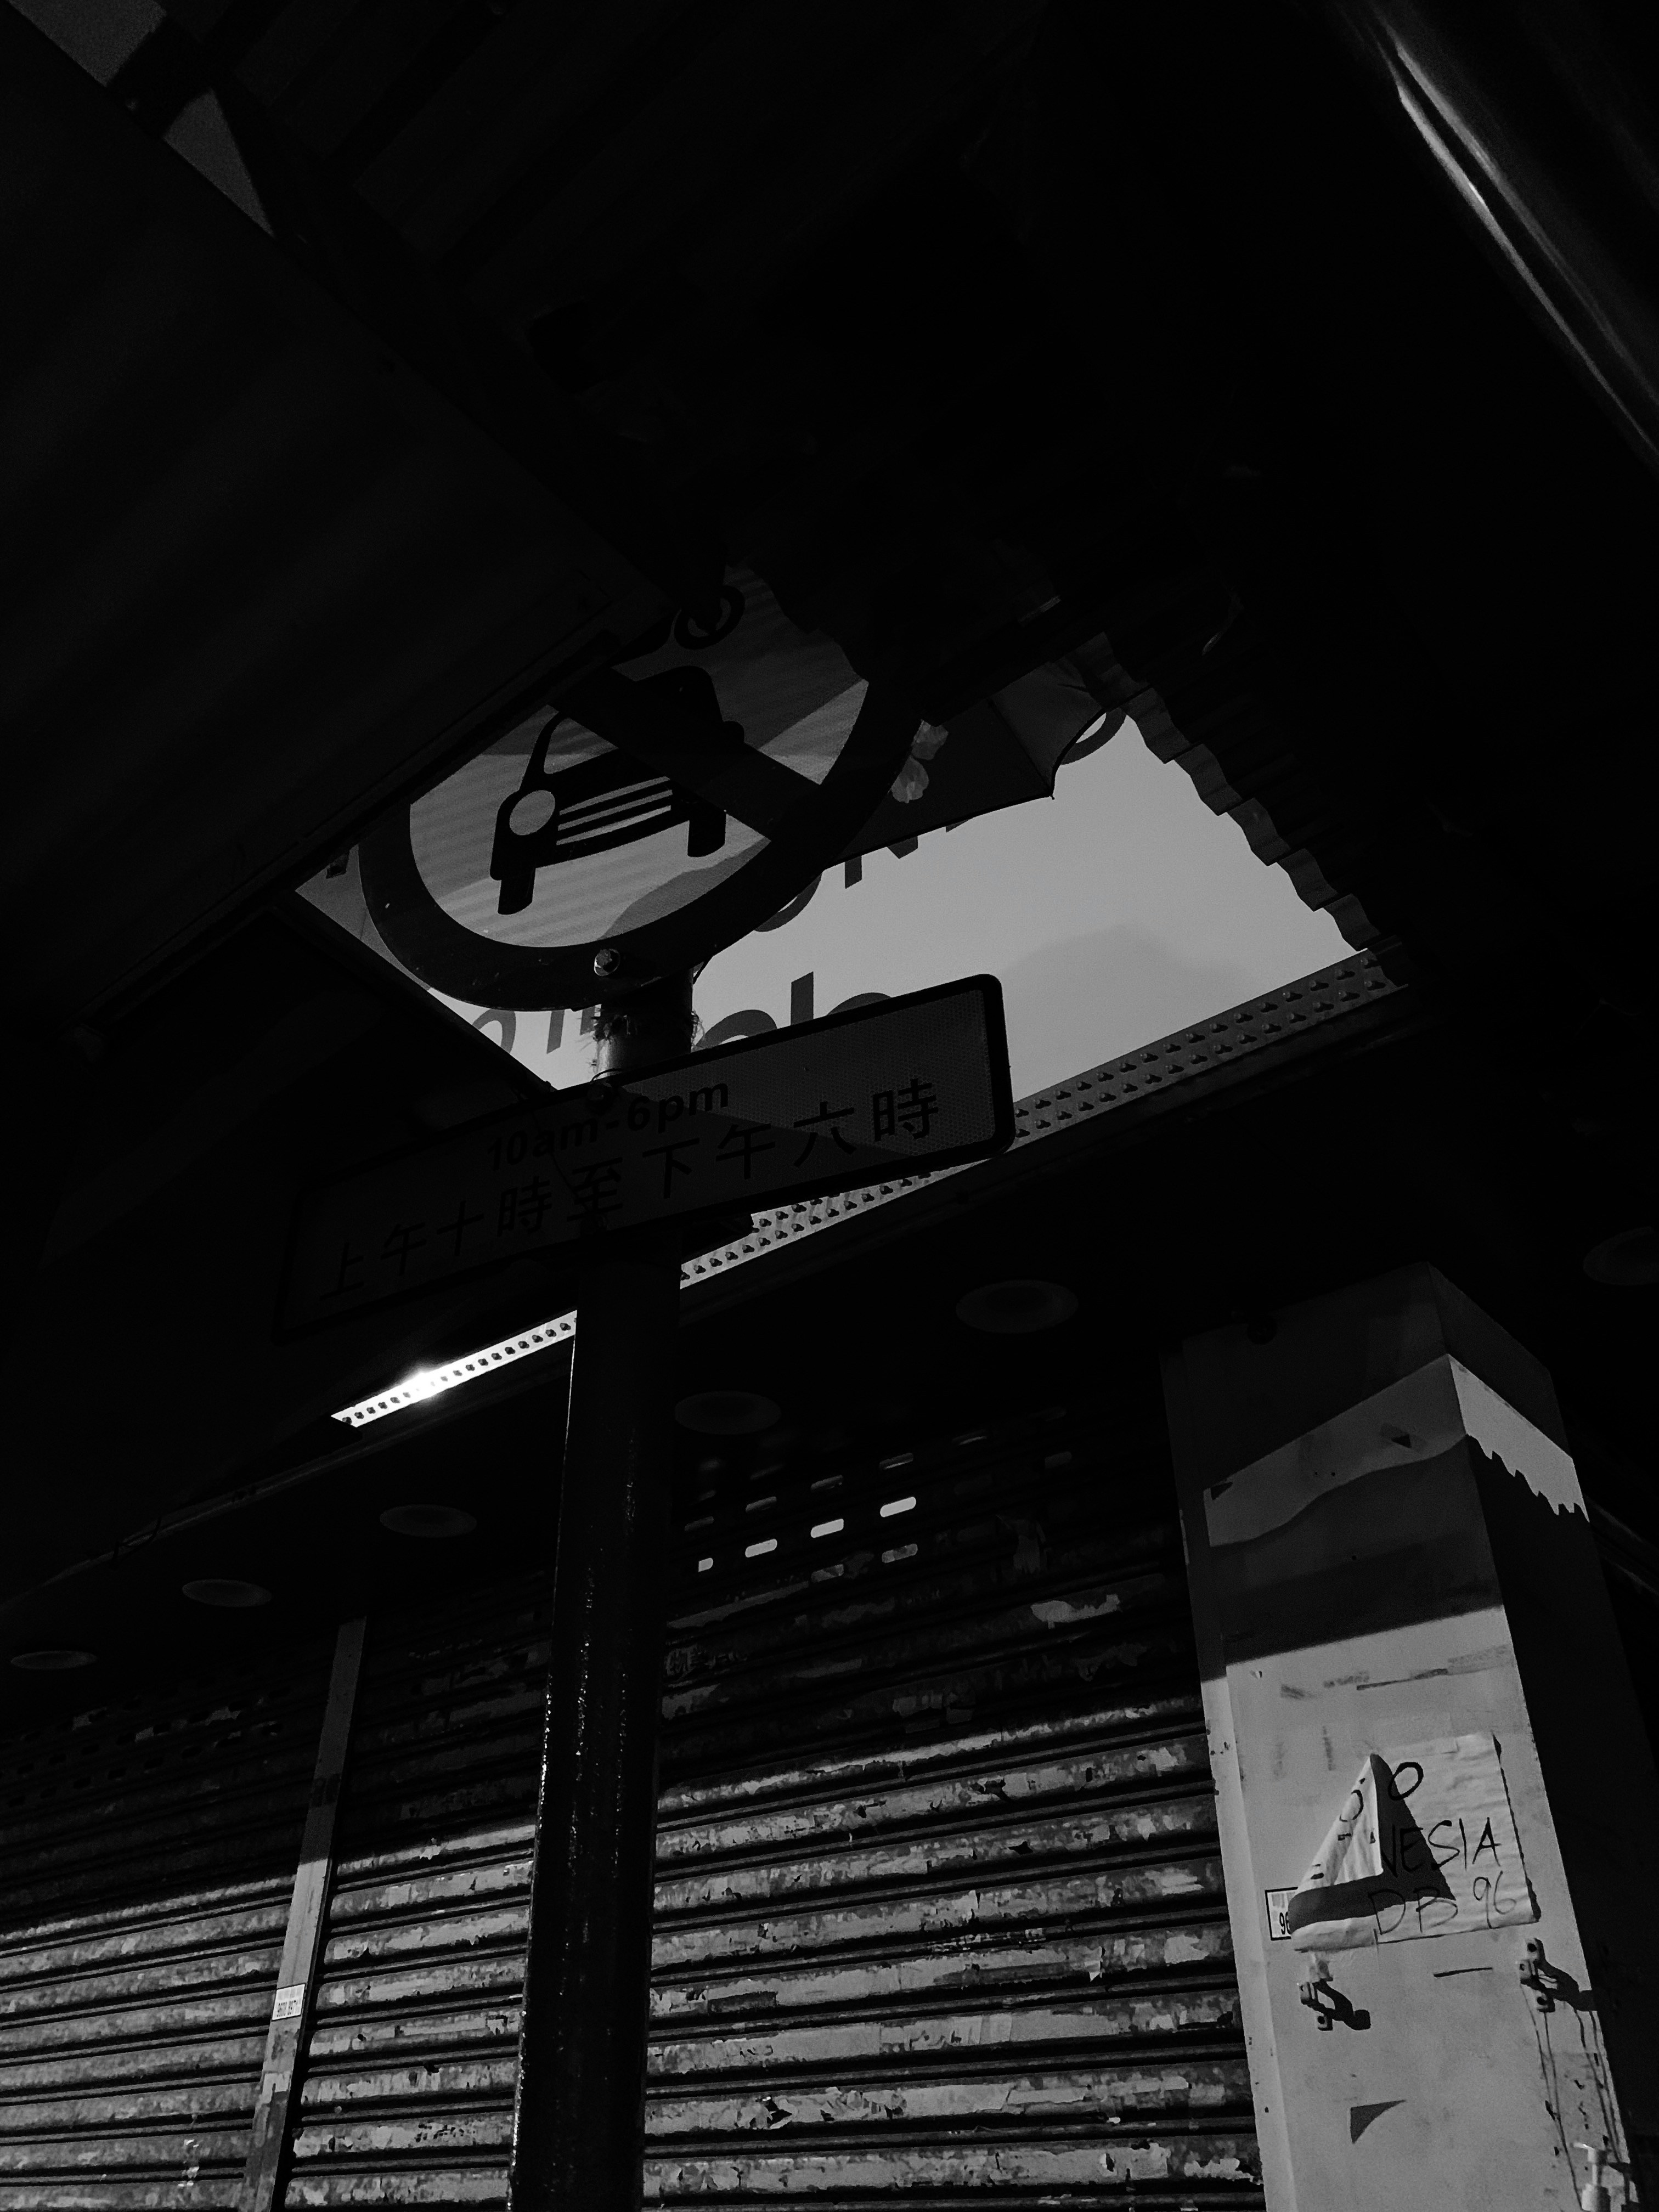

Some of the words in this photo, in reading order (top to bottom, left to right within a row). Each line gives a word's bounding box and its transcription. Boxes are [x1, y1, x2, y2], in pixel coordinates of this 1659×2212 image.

[319, 1077, 939, 1301] 上午十時至下午六時
[488, 1082, 729, 1171] 10am-6pm
